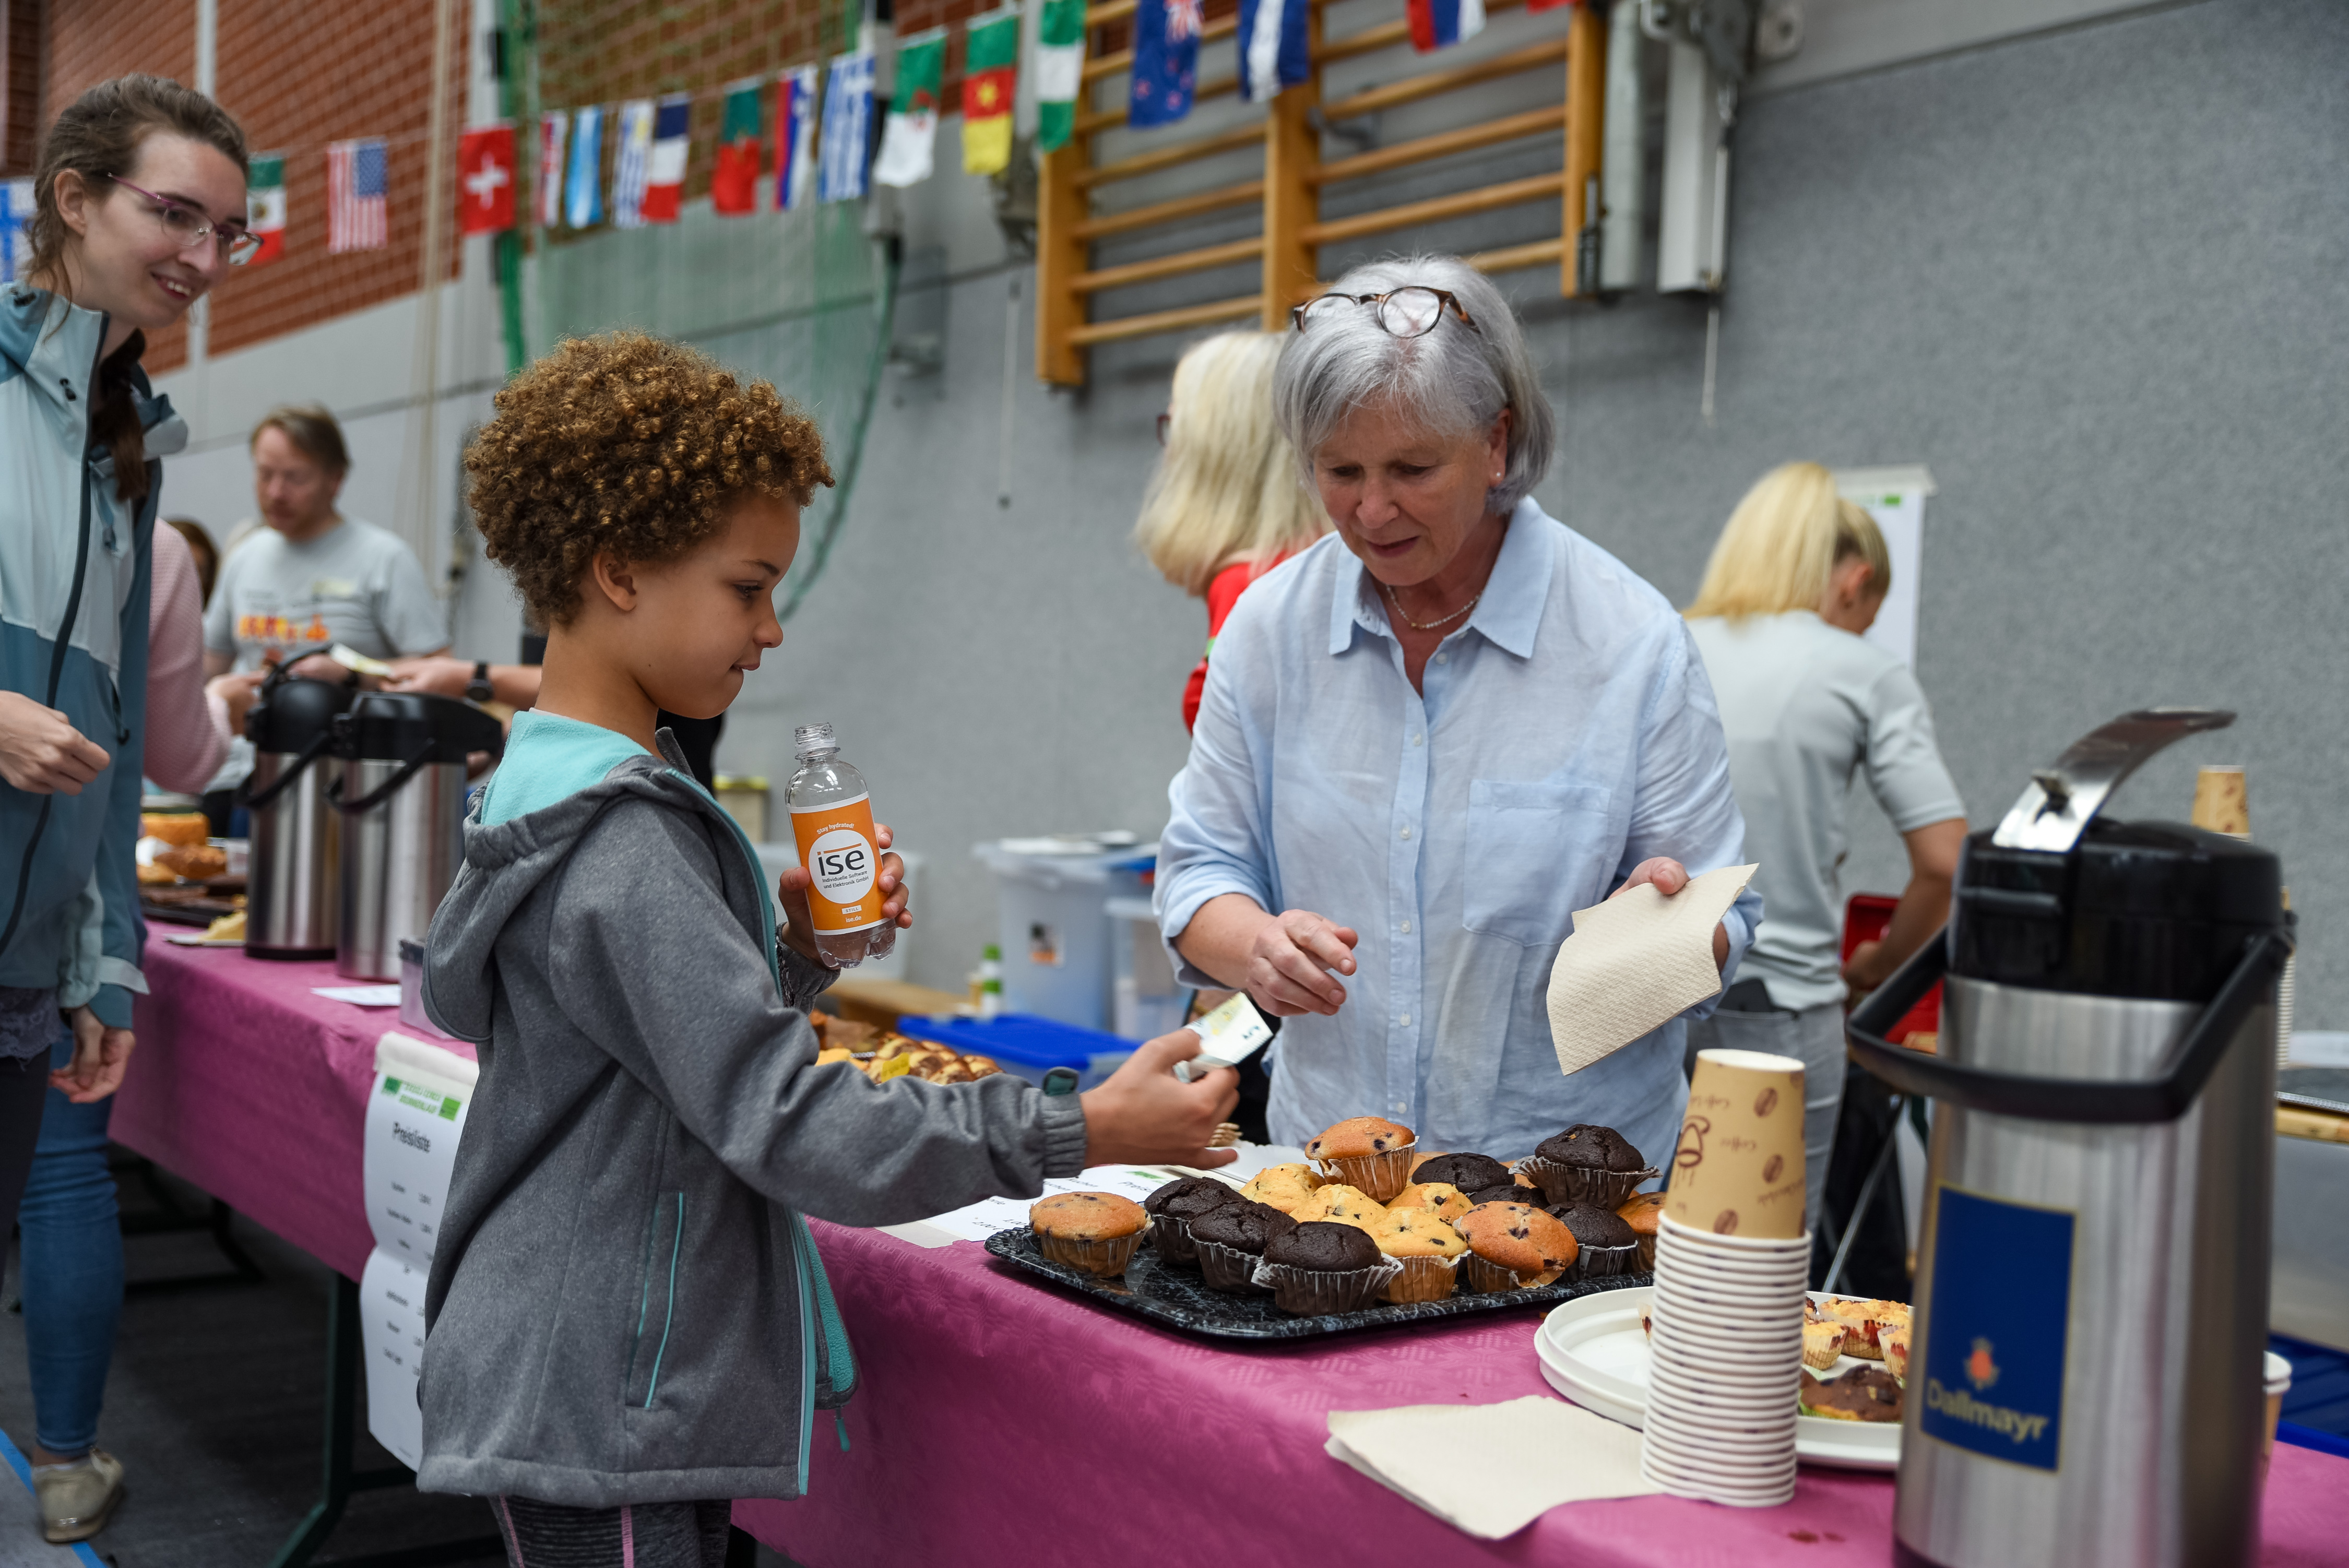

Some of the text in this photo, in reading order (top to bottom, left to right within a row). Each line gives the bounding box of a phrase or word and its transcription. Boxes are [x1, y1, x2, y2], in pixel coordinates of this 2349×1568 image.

[816, 826, 828, 835] Stay
[817, 849, 865, 876] ise
[822, 870, 868, 883] Individuelle Software
[833, 880, 856, 888] Elektronik
[393, 1121, 431, 1154] Preisliste
[1043, 1181, 1071, 1191] uchen
[1927, 1378, 2049, 1444] Dallmayr
